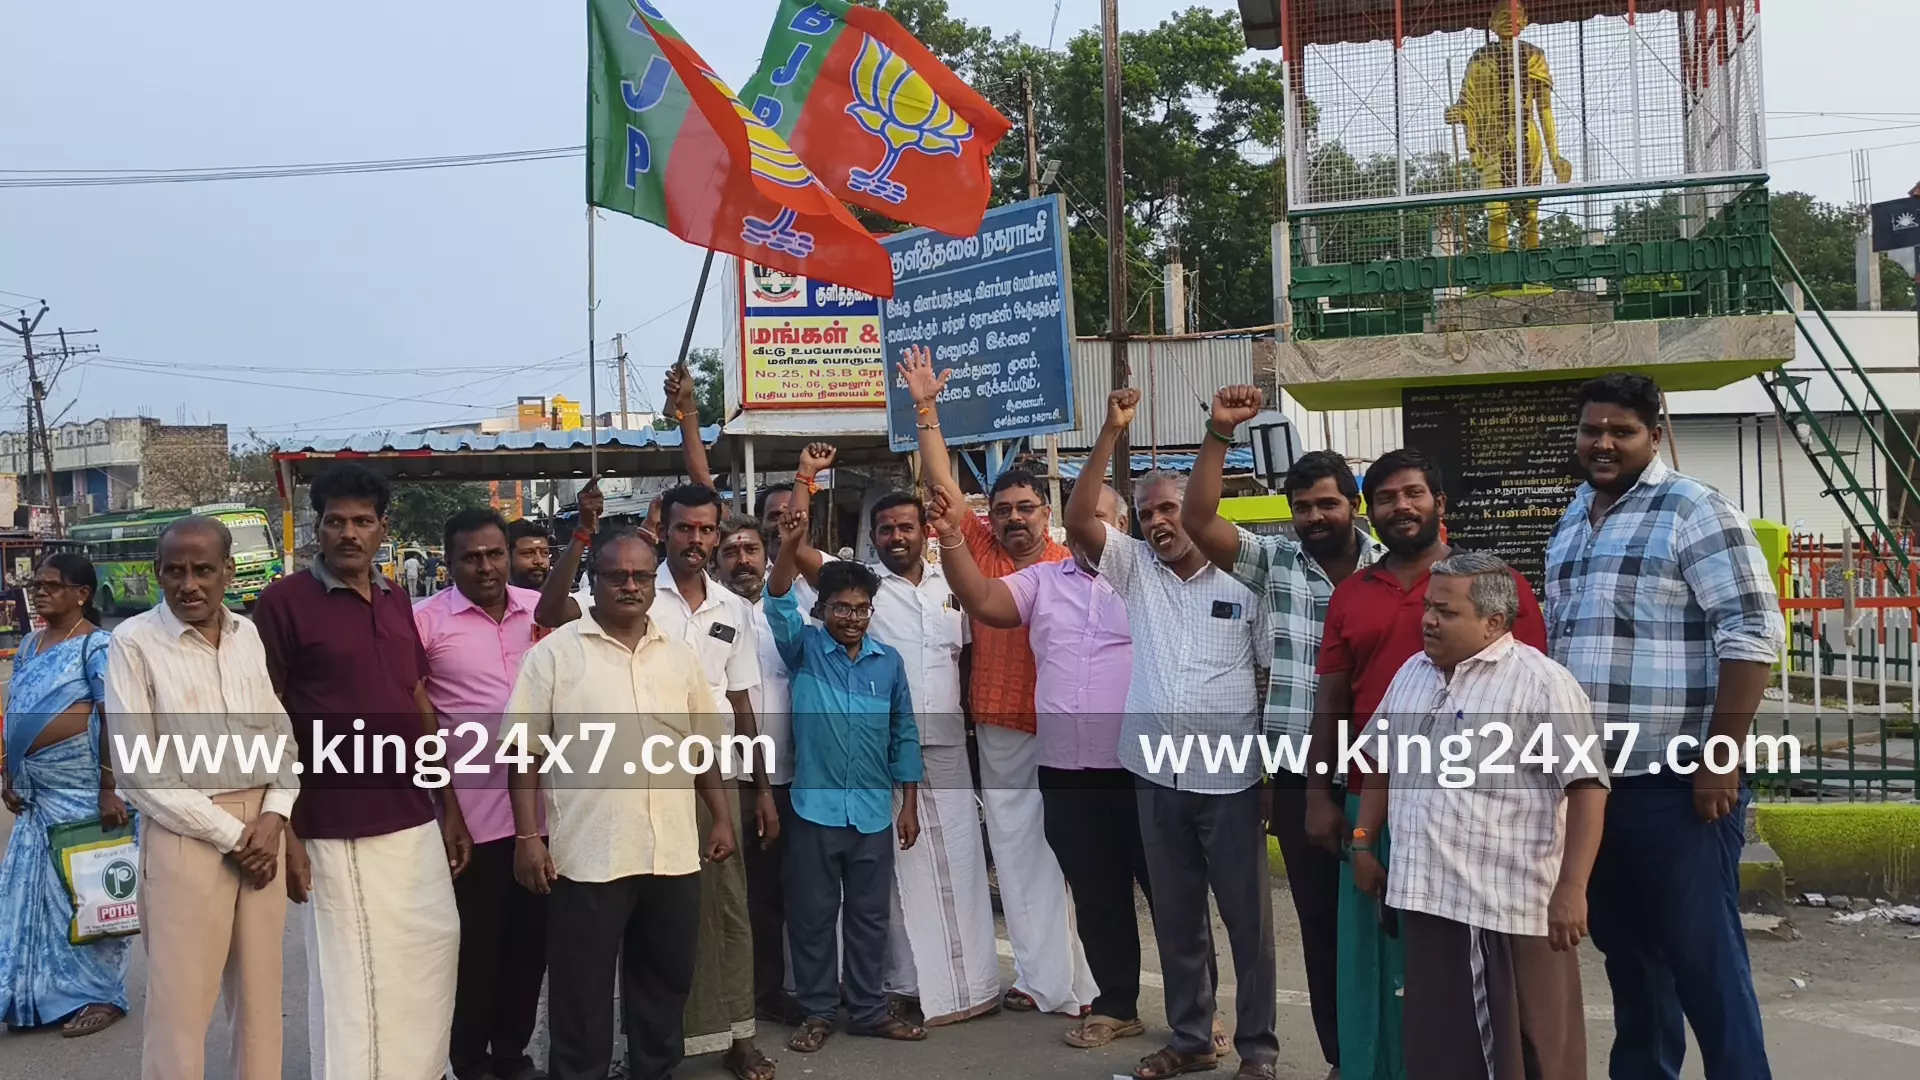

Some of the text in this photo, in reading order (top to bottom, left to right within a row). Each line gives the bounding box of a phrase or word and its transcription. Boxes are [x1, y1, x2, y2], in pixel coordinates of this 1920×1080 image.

[981, 210, 1048, 260] நகராட்சி
[859, 324, 879, 344] &
[791, 346, 881, 356] உபயோகப்பெ
[936, 337, 979, 362] அனுமதி
[822, 357, 883, 366] பொருட்க
[101, 903, 137, 920] POTHY
